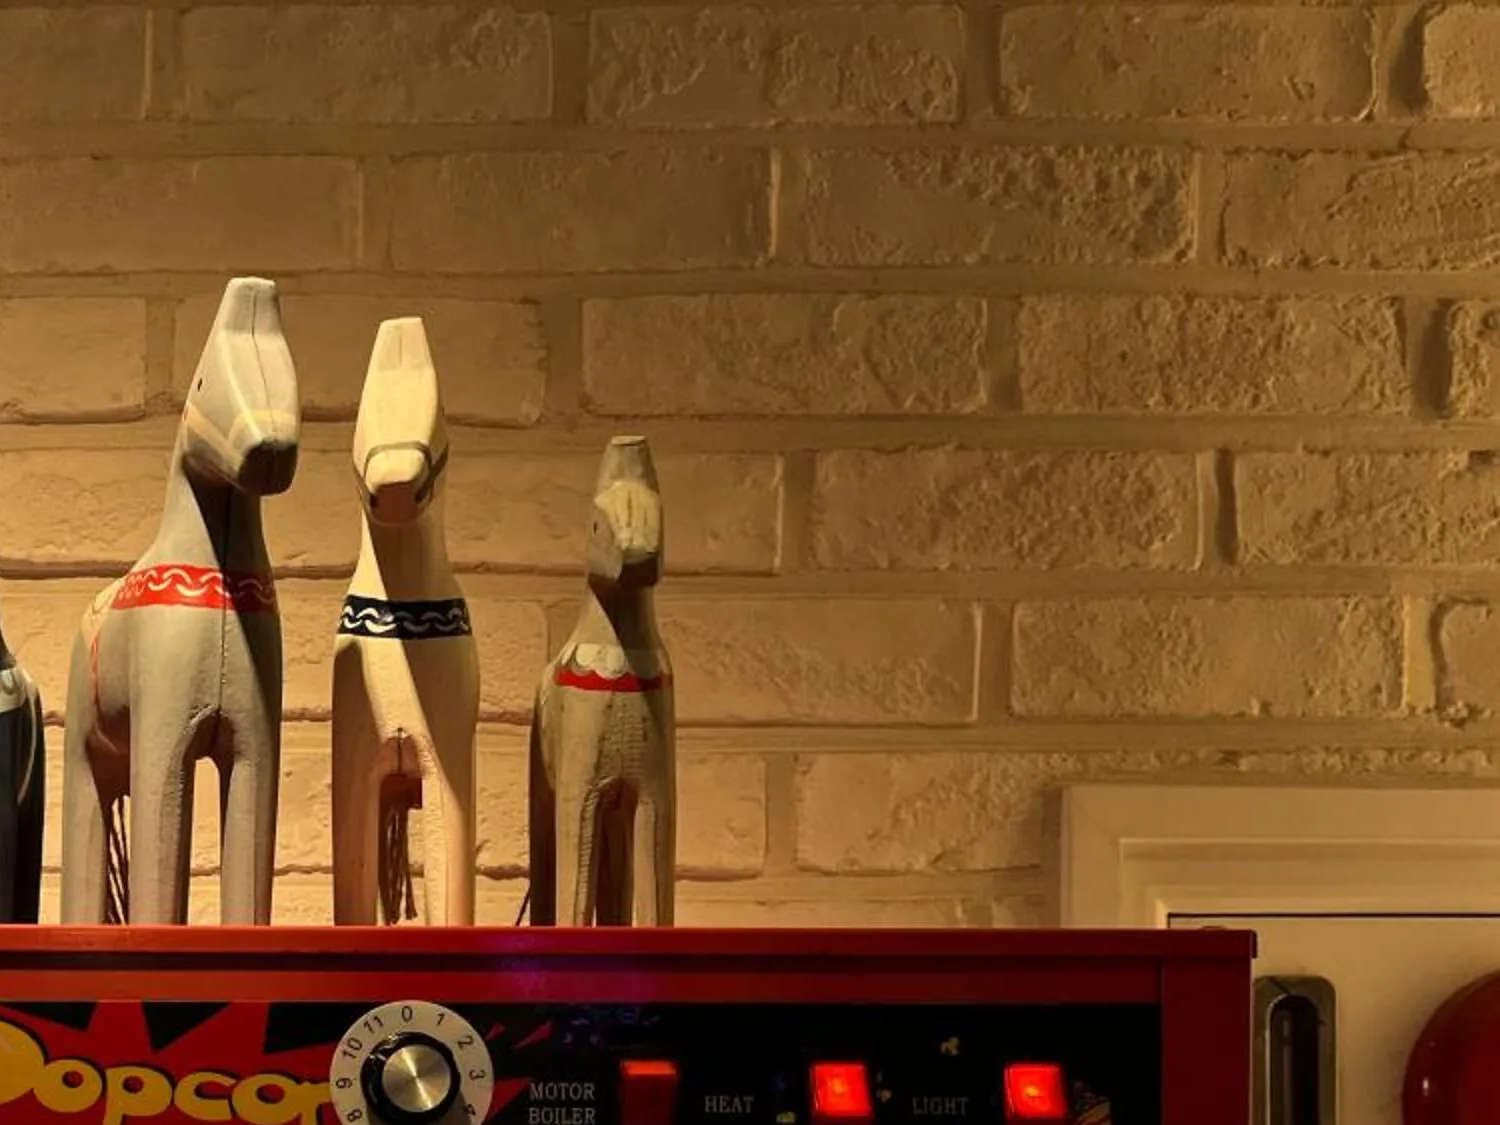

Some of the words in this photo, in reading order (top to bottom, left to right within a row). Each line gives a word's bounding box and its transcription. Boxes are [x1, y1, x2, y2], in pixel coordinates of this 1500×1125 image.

[401, 1005, 413, 1023] 0
[435, 1013, 445, 1027] 1
[363, 1014, 385, 1034] 11
[342, 1037, 363, 1059] 10
[457, 1035, 474, 1050] 2
[335, 1077, 353, 1089] 9
[468, 1069, 486, 1081] 3
[528, 1082, 596, 1100] MOTOR
[704, 1095, 755, 1113] HEAT
[911, 1096, 969, 1116] LIGHT
[346, 1108, 363, 1123] 8
[528, 1107, 596, 1125] BOILER
